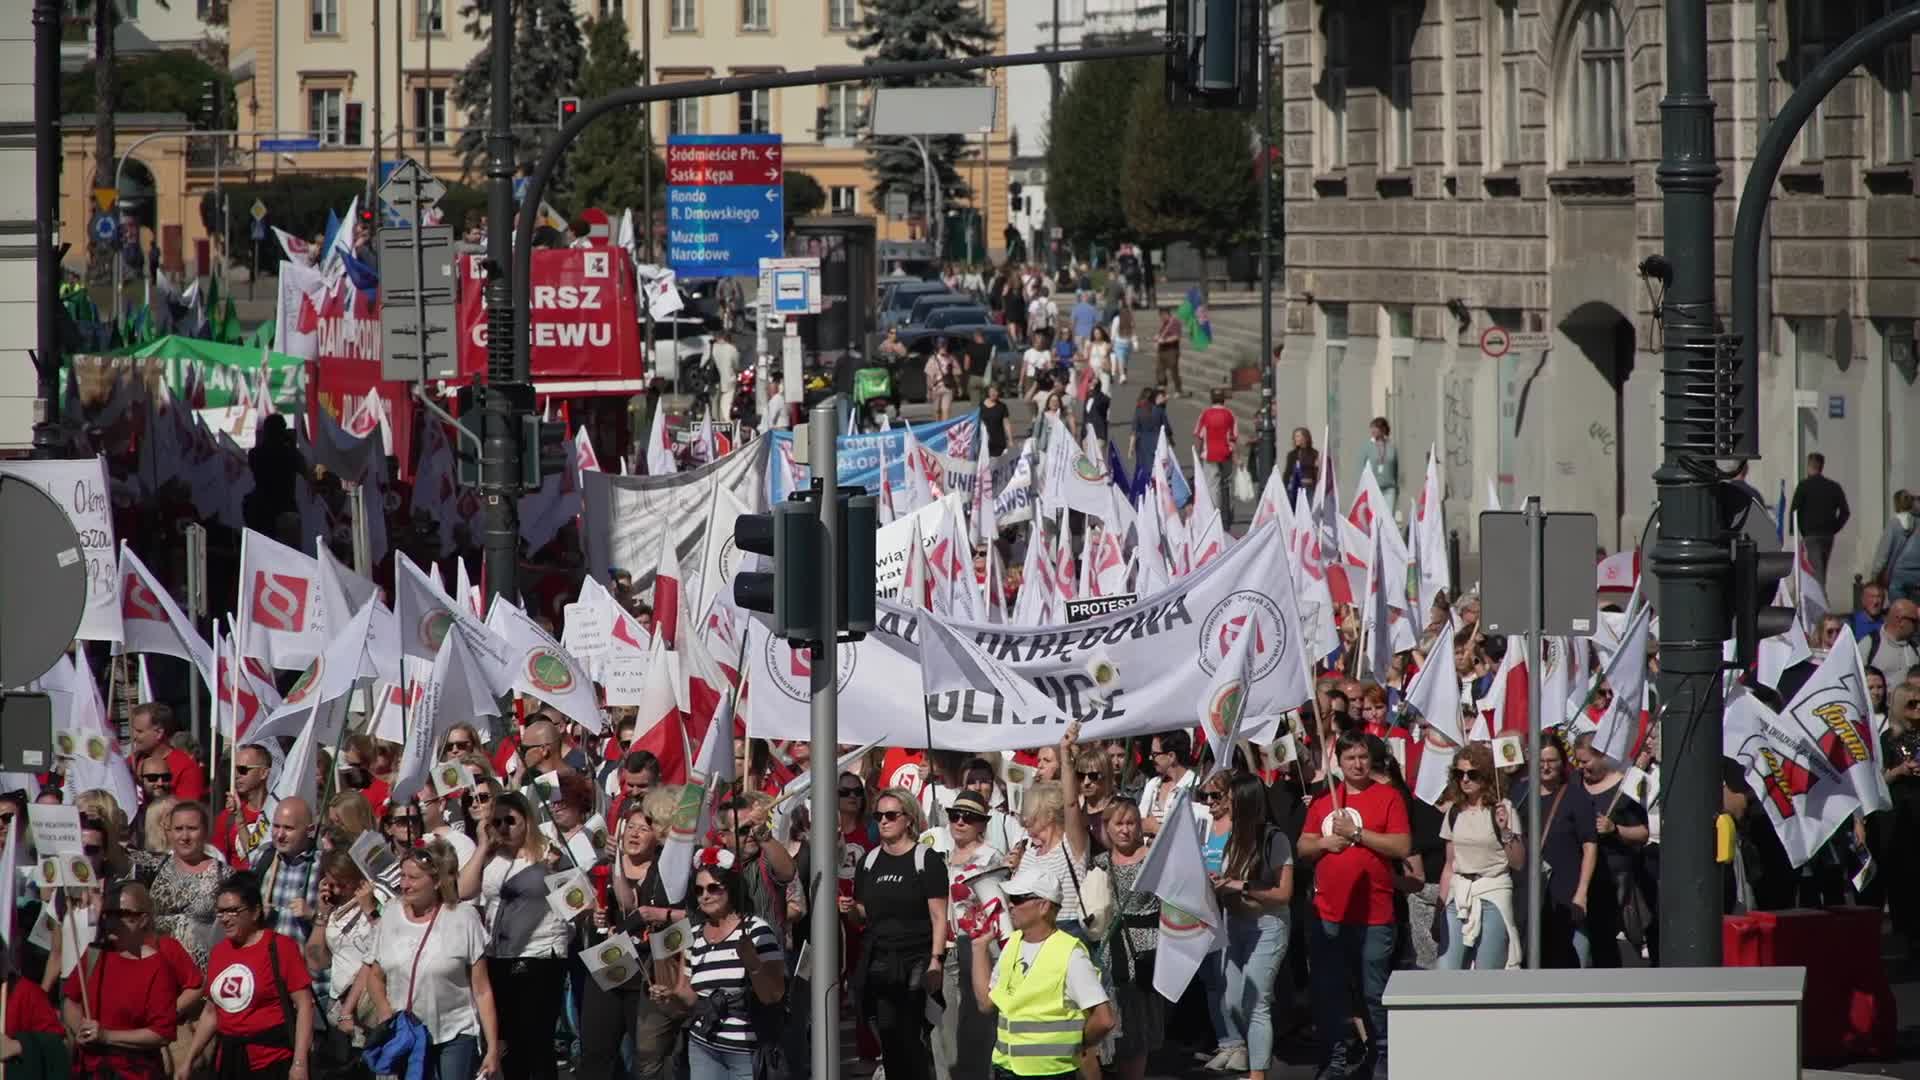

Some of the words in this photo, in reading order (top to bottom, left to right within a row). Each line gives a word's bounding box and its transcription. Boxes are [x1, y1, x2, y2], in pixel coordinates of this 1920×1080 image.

[670, 146, 738, 161] Śródmieście
[740, 148, 760, 161] Pn.
[671, 168, 703, 182] Saska
[705, 168, 734, 185] Kępa
[671, 189, 707, 203] Rondo
[671, 207, 682, 220] R.
[684, 206, 760, 223] Dmowskiego
[671, 230, 720, 243] Muzeum
[671, 247, 730, 261] Narodowe
[472, 323, 612, 347] GEWU
[1070, 596, 1137, 618] PROTEST
[1812, 704, 1869, 762] forum
